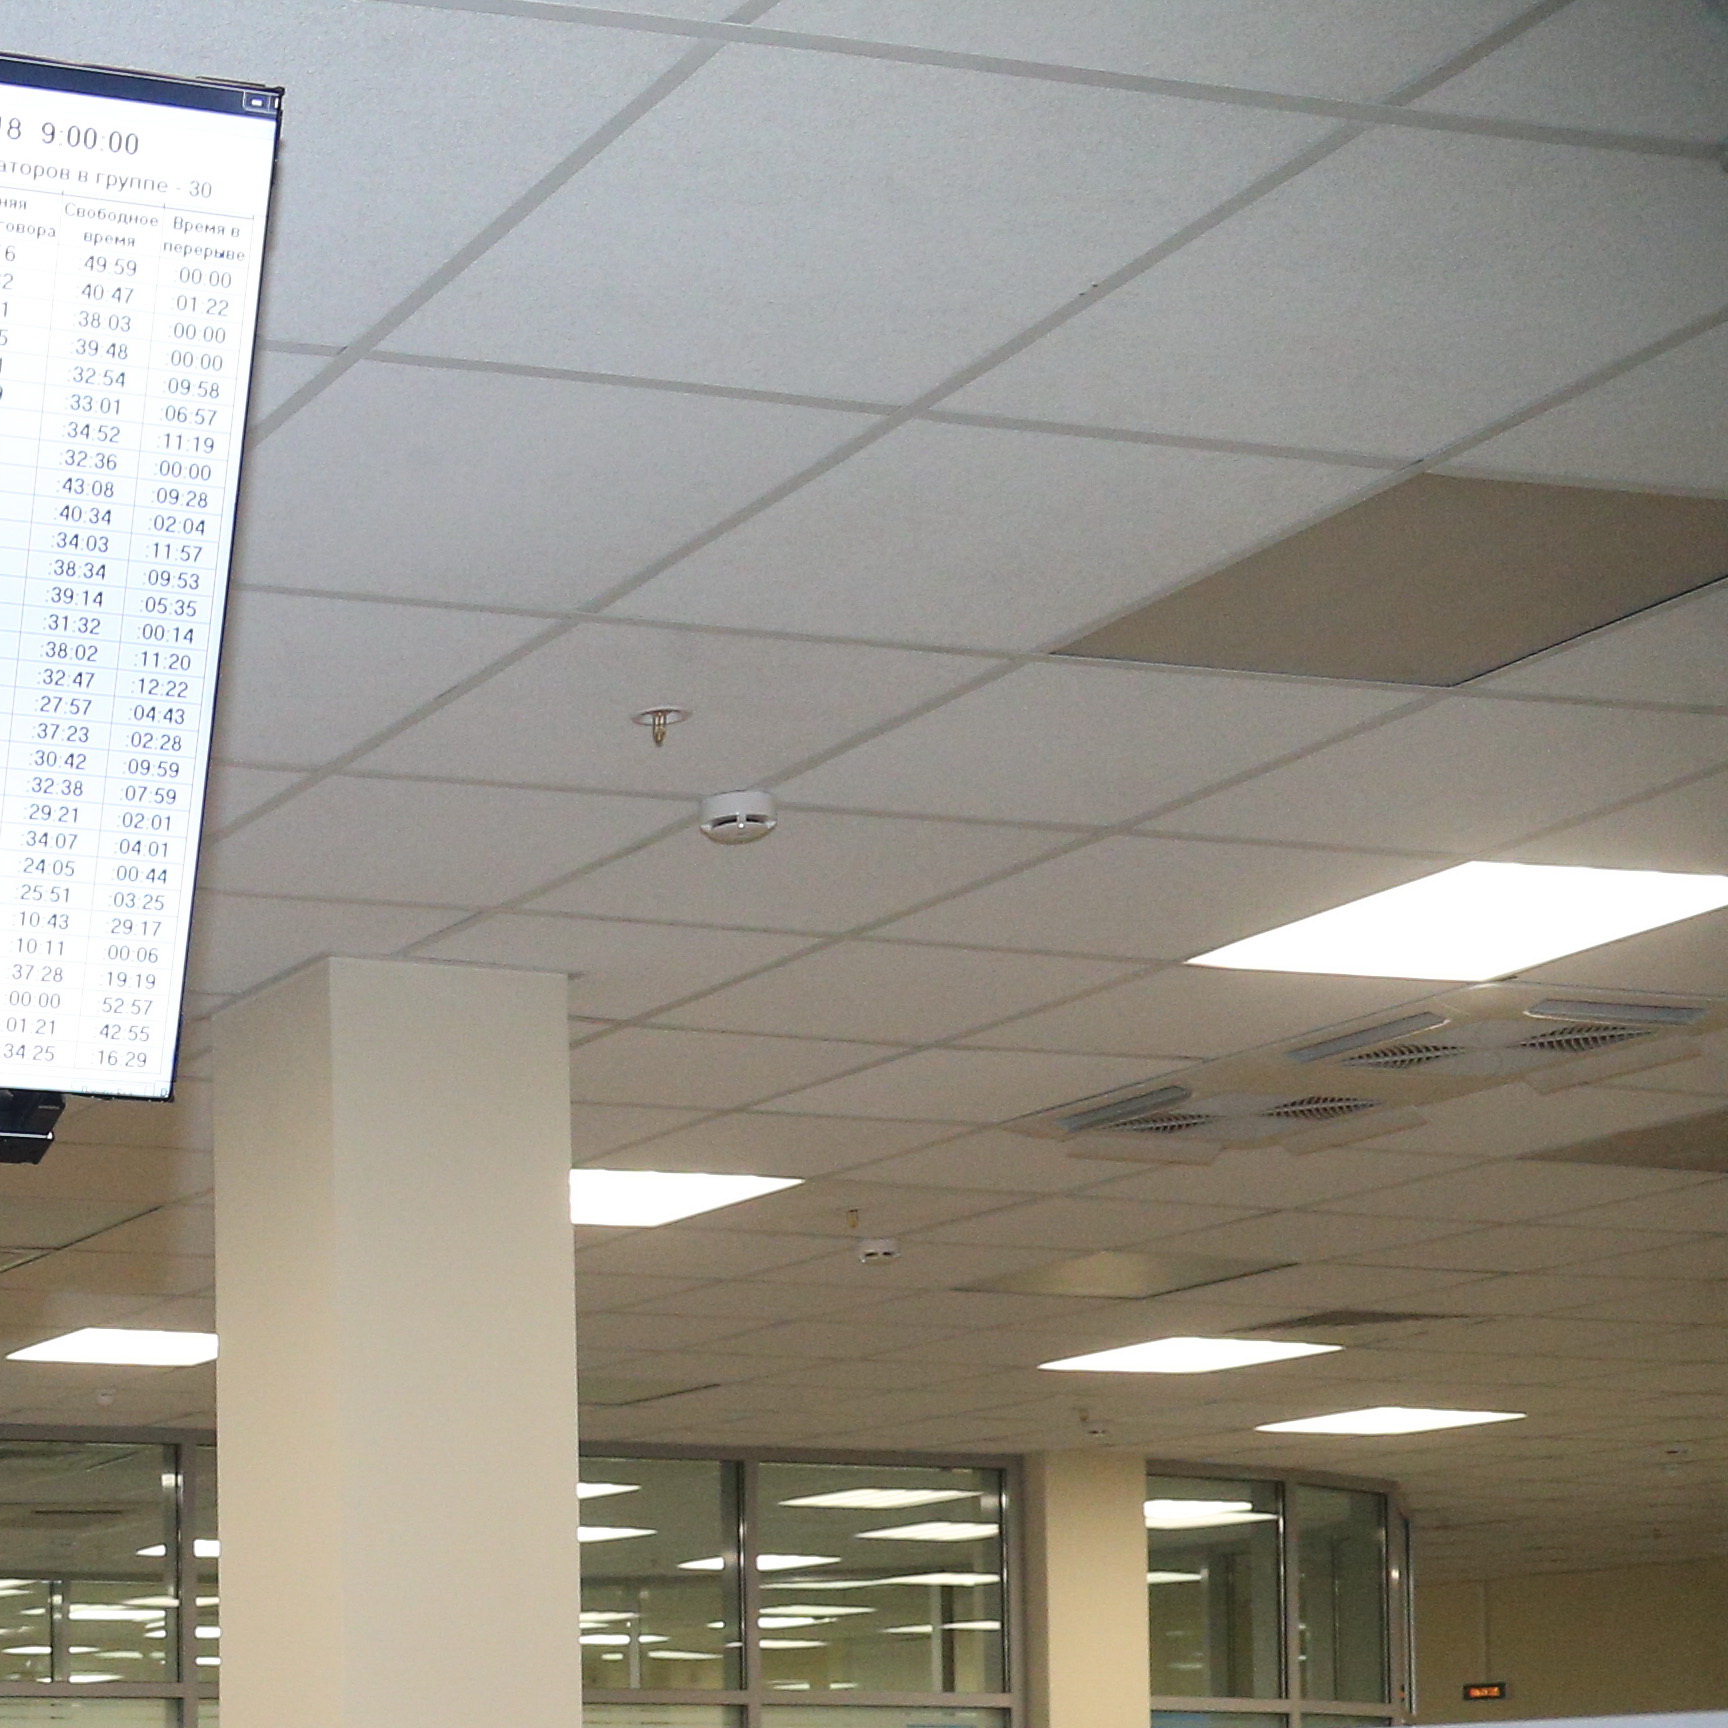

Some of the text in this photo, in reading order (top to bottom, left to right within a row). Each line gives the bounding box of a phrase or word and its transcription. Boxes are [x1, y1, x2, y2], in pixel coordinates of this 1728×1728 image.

[41, 121, 140, 156] 9:00:00
[77, 170, 89, 183] в
[95, 172, 169, 193] группе
[188, 180, 213, 199] 30
[64, 202, 159, 227] Свободное
[83, 231, 136, 248] время
